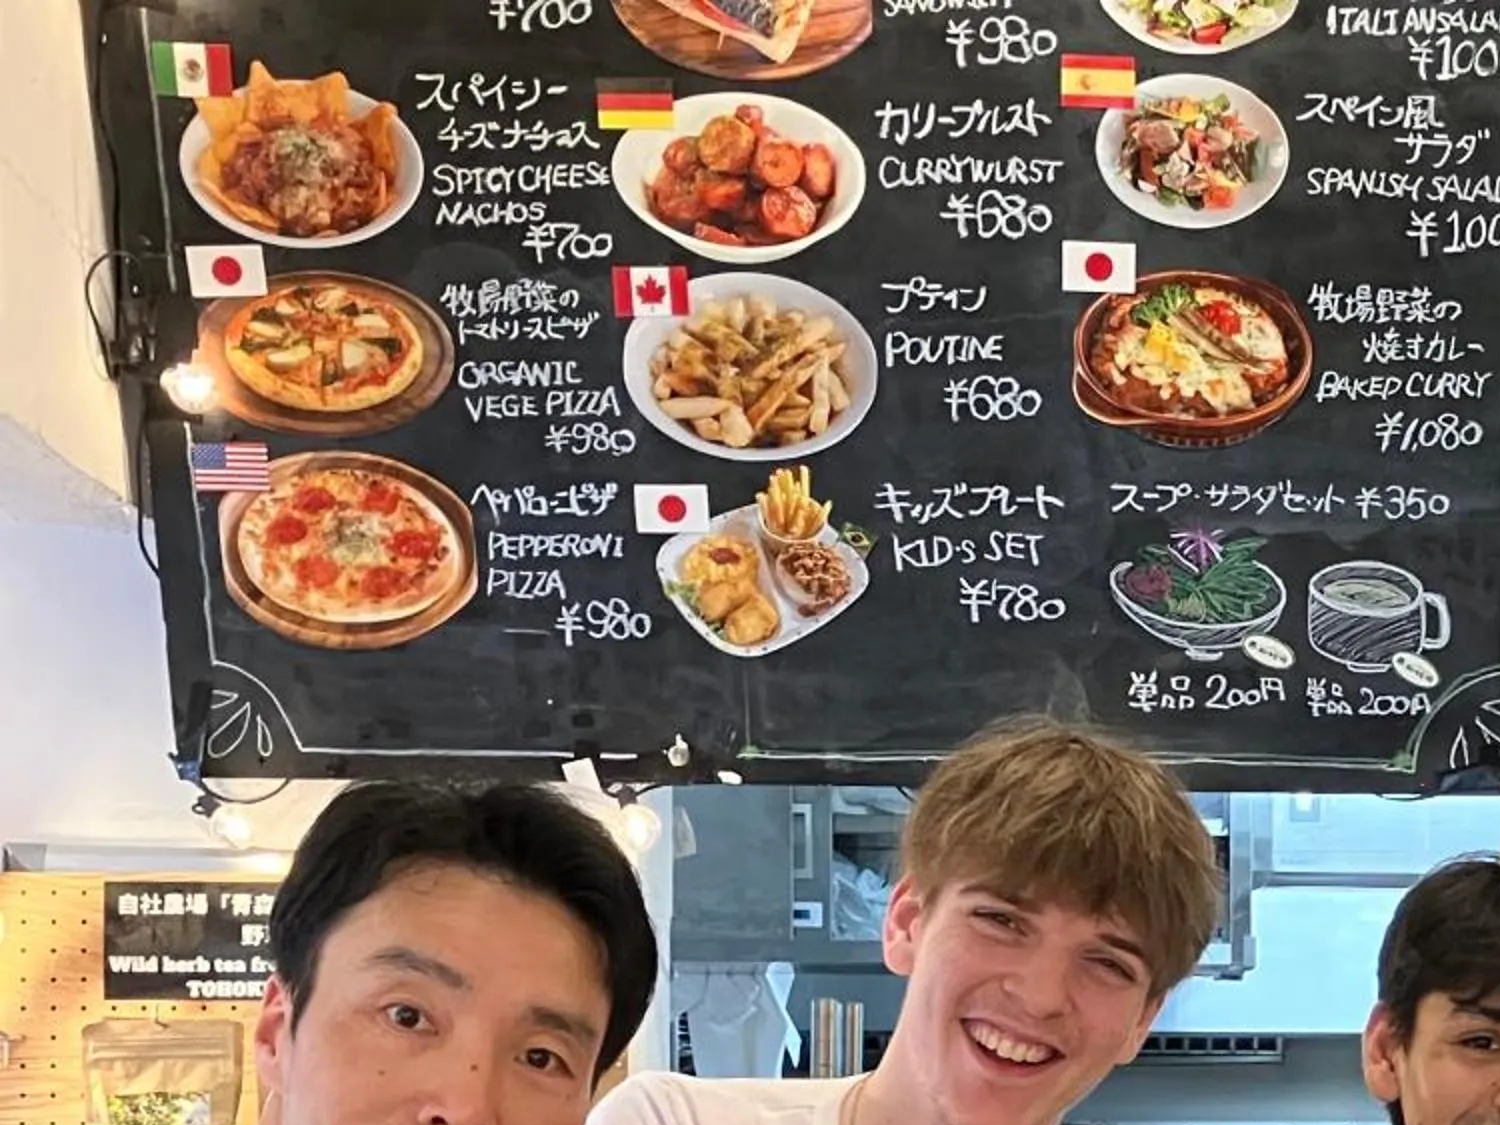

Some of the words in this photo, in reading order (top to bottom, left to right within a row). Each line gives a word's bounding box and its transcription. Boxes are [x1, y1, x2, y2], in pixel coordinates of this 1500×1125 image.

[489, 0, 593, 32] ¥700
[1326, 5, 1436, 35] ITALIAN
[945, 16, 1058, 67] ¥980
[415, 72, 568, 111] スパイシー
[1296, 94, 1445, 129] スペイン風
[437, 117, 601, 151] チーズナチョス
[1394, 128, 1490, 168] サラダ
[432, 163, 515, 197] SPICY
[517, 161, 611, 194] CHEESE
[879, 153, 1064, 188] CURRYWURST
[1307, 168, 1423, 201] SPANISH
[435, 201, 547, 228] NACHOS
[939, 189, 1052, 238] ¥680
[522, 221, 613, 264] ¥700
[1307, 280, 1462, 323] 牧場野菜の
[885, 331, 1004, 368] POUTINE
[1362, 326, 1485, 364] 焼きカレー
[457, 360, 582, 389] ORGANIC
[1315, 371, 1402, 403] BAKED
[1405, 371, 1493, 399] CURRY
[465, 395, 539, 423] VEGE
[545, 386, 621, 417] PIZZA
[944, 375, 1042, 421] ¥680
[544, 422, 636, 455] ¥980
[1375, 411, 1483, 452] ¥1,080
[874, 482, 1065, 524] キッズプレート
[1355, 485, 1450, 520] ¥350
[488, 531, 623, 561] PEPPERONI
[983, 530, 1044, 567] SET
[487, 568, 567, 600] PIZZA
[959, 577, 1065, 622] ¥780
[554, 597, 651, 646] ¥980
[1128, 670, 1195, 712] 単品
[1307, 677, 1353, 716] 単品
[108, 955, 158, 973] Wild
[162, 955, 210, 973] herb
[214, 958, 246, 973] tea
[251, 955, 277, 973] fr
[186, 979, 264, 998] TOHOK
